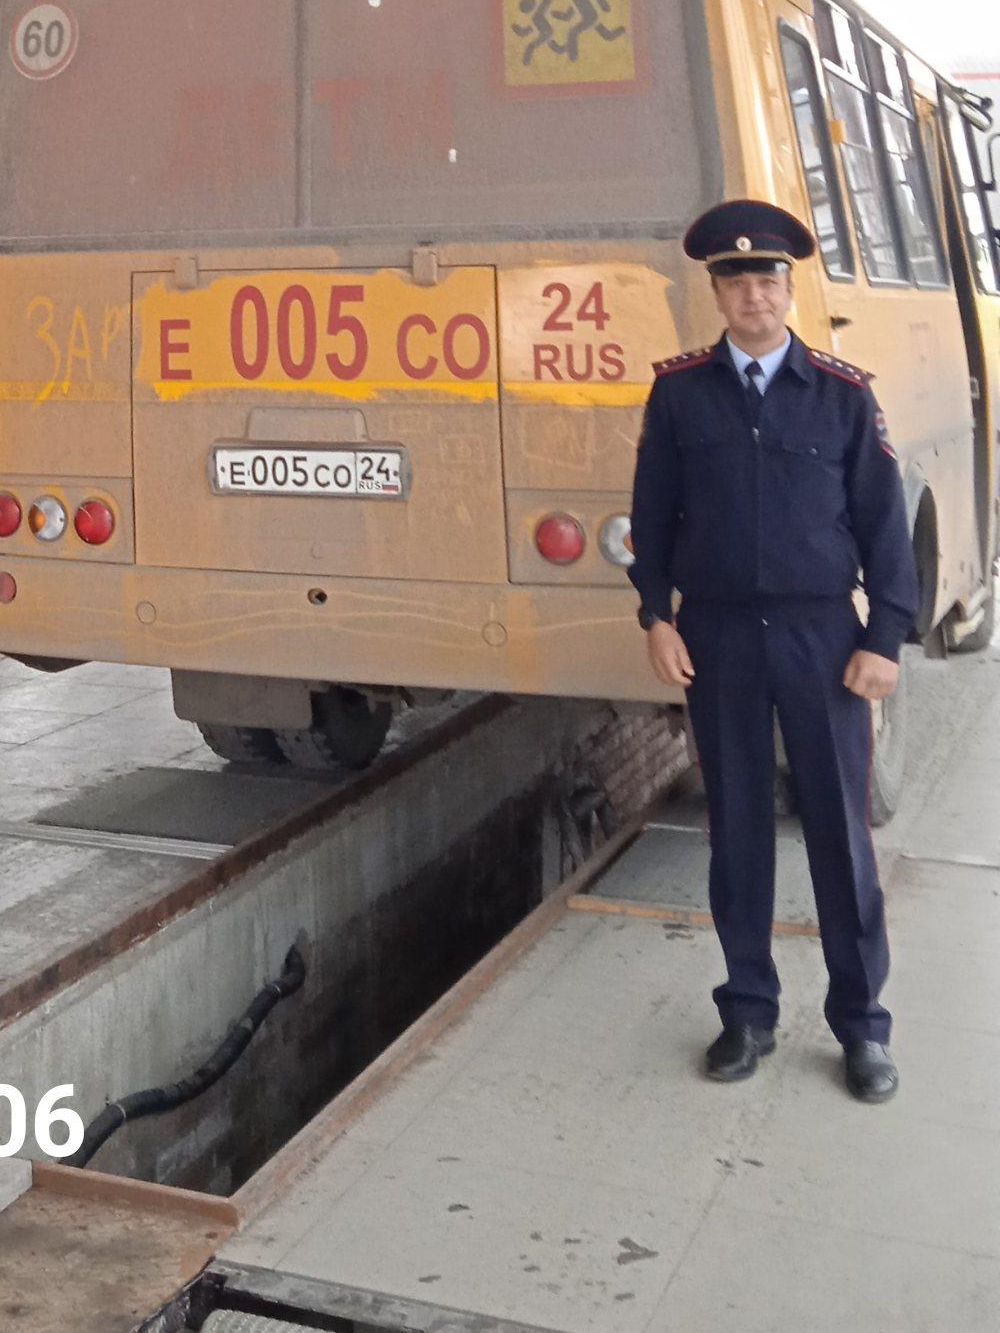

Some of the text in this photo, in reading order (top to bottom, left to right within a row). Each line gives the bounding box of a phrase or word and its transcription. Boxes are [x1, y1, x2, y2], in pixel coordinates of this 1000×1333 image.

[23, 20, 64, 58] 60
[160, 282, 610, 380] E 005 CO 24
[533, 343, 626, 382] RUS
[359, 480, 382, 491] RUS
[361, 456, 391, 481] 24
